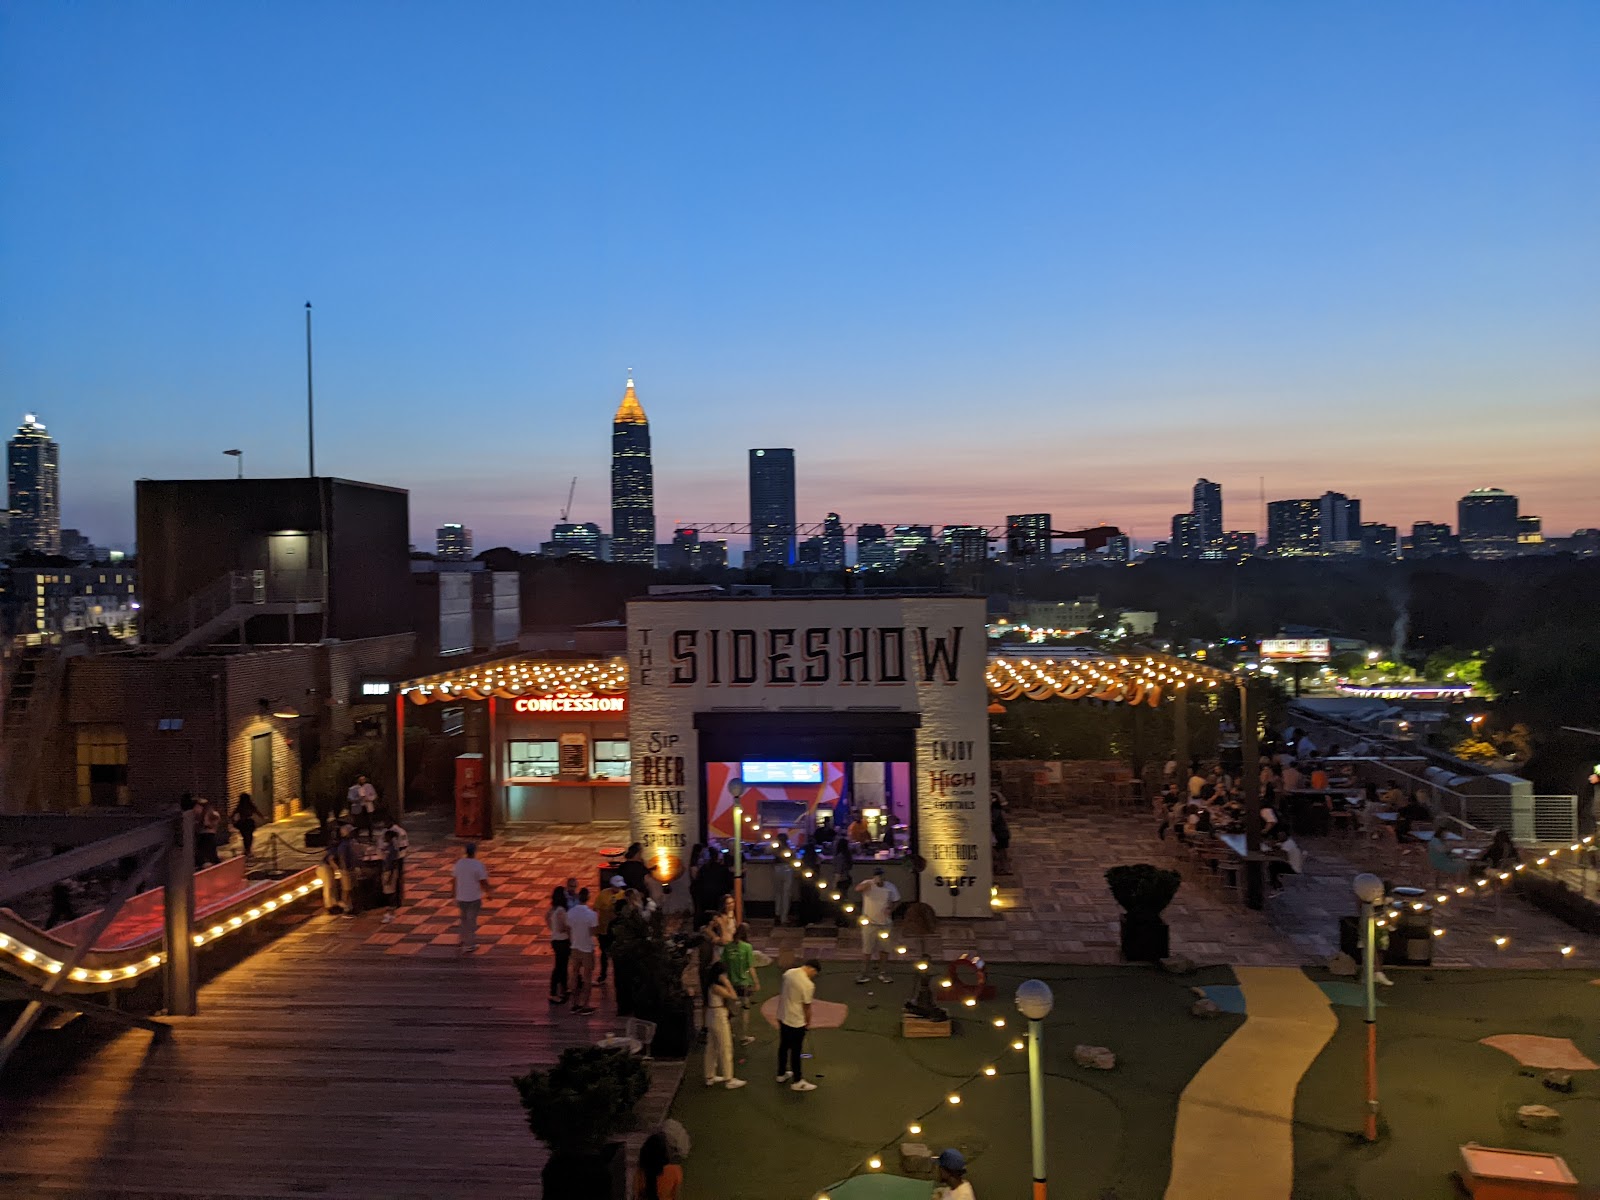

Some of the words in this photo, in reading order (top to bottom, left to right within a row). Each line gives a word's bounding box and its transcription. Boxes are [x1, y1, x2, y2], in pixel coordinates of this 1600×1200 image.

[637, 628, 653, 686] THE
[668, 626, 964, 688] SIDESHOW
[514, 698, 625, 712] CONCESSION
[932, 741, 974, 760] ENJOY
[643, 756, 684, 786] BEER
[643, 790, 686, 814] WINE
